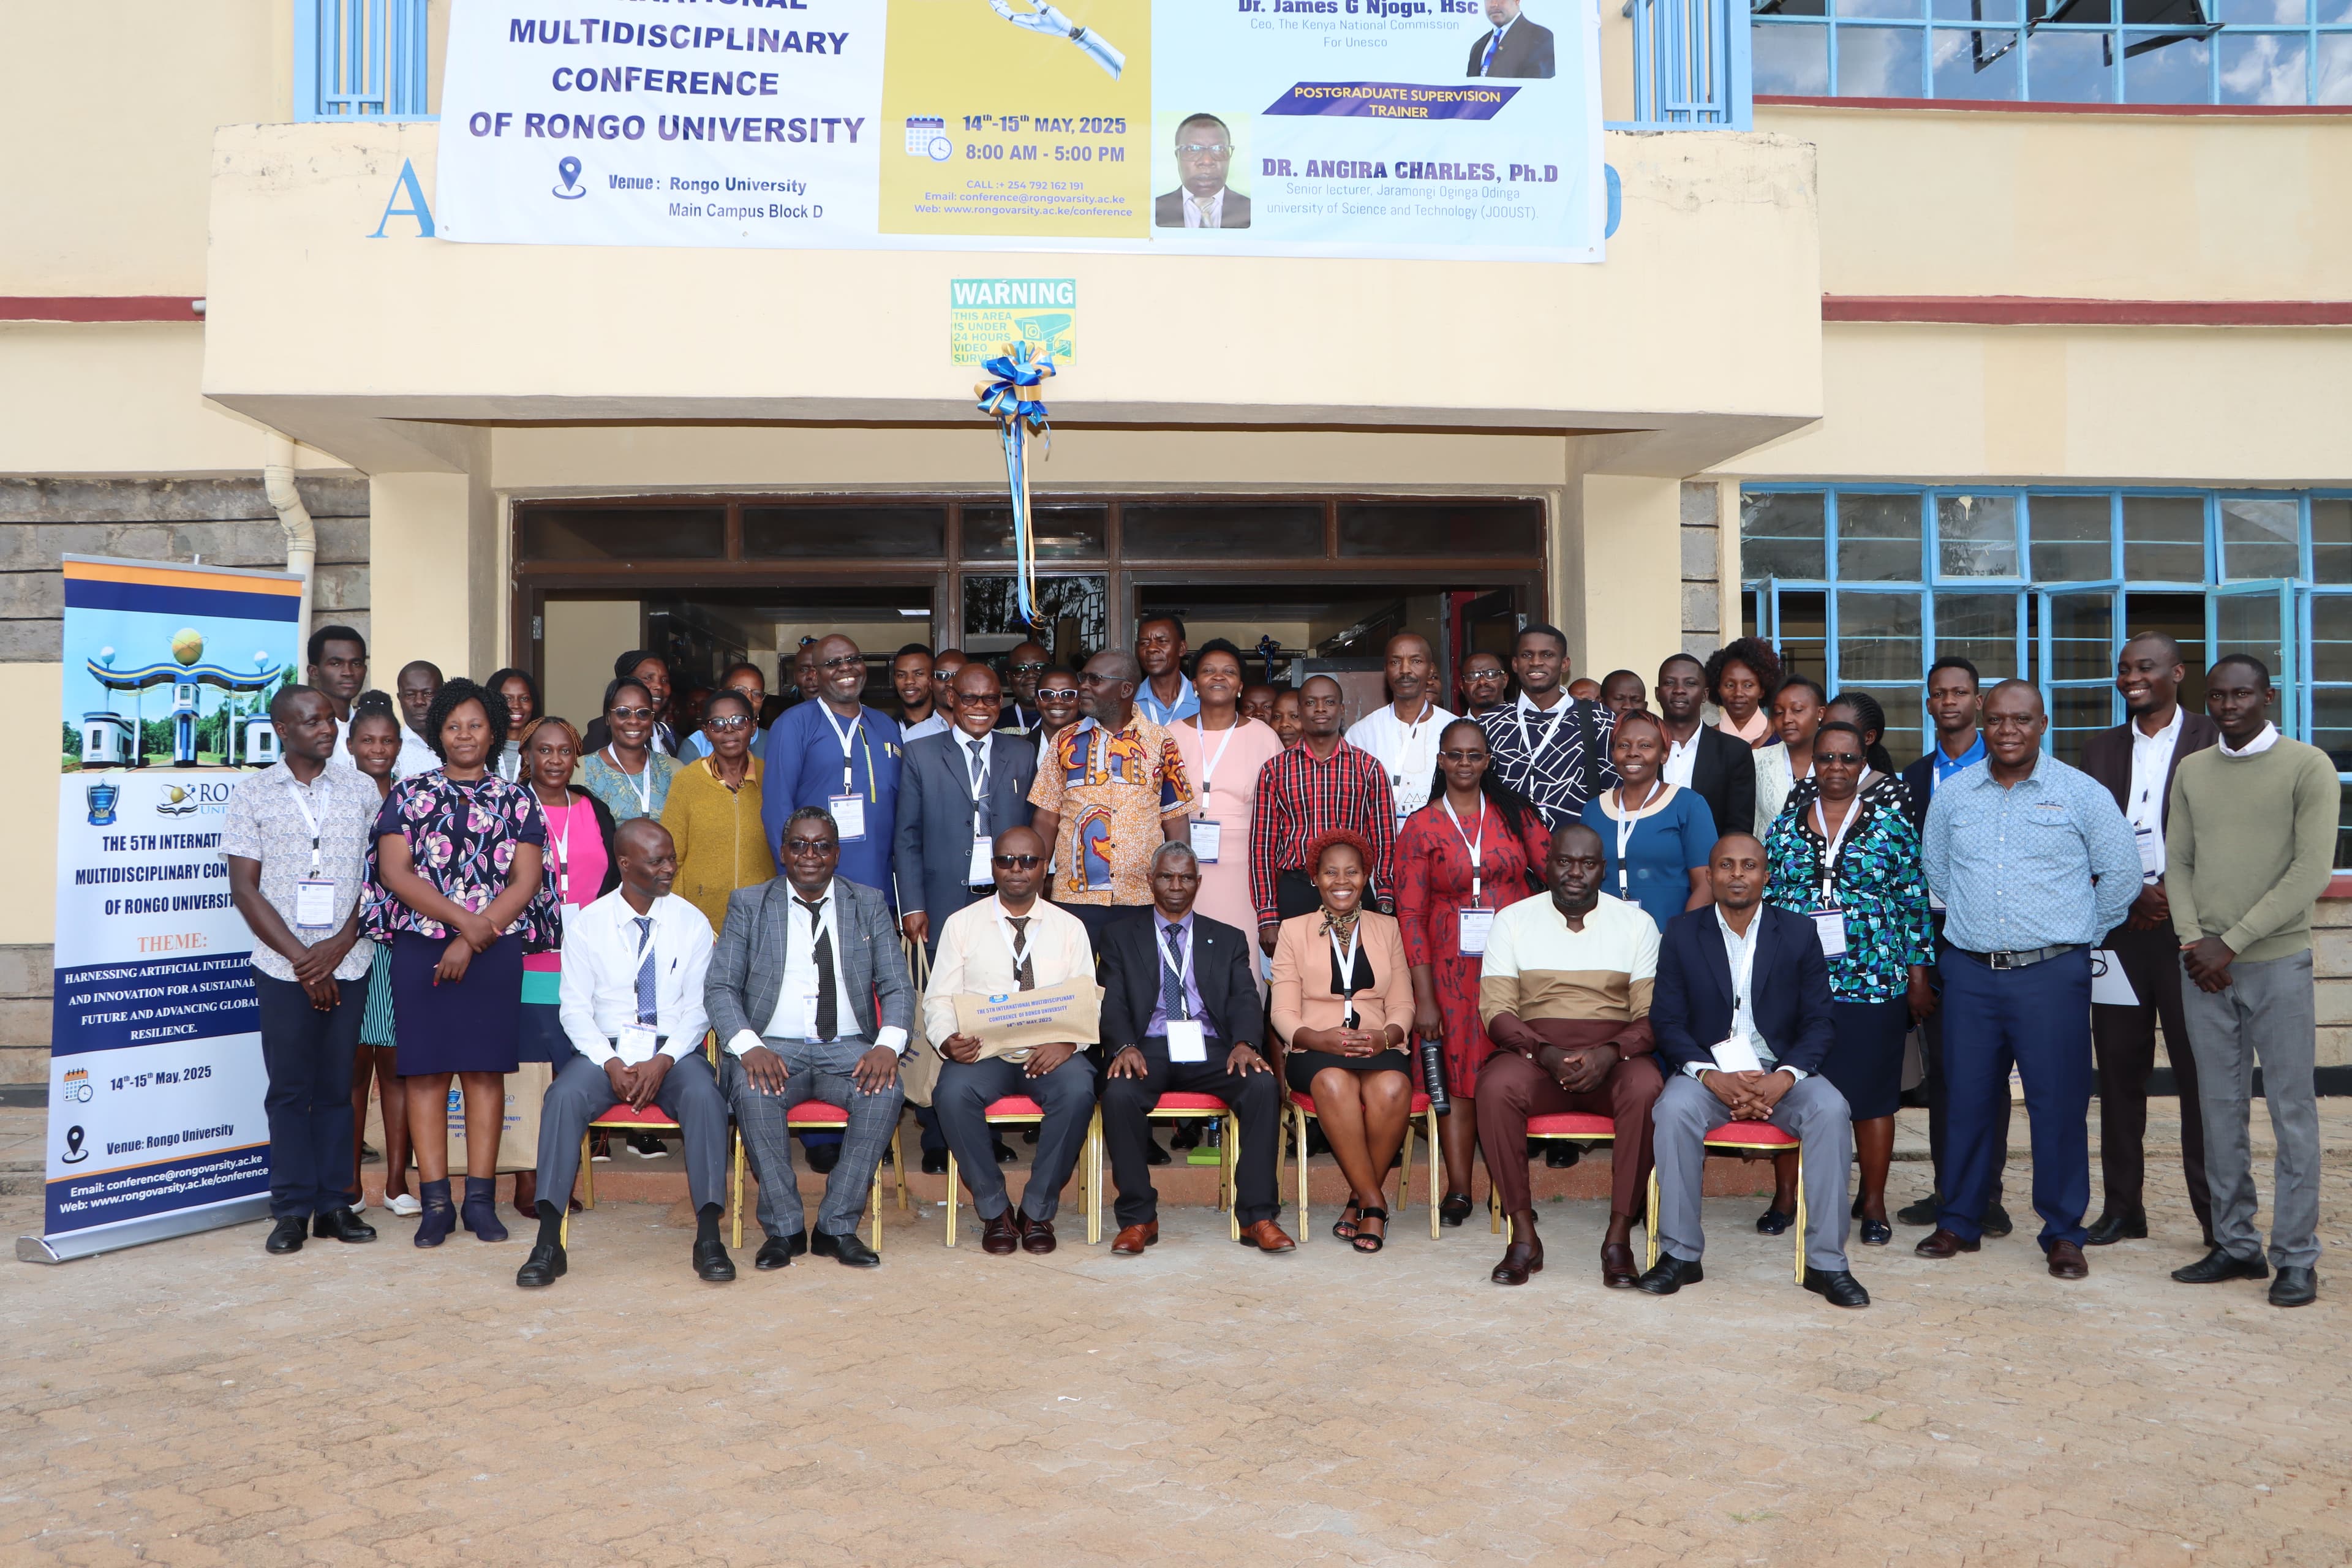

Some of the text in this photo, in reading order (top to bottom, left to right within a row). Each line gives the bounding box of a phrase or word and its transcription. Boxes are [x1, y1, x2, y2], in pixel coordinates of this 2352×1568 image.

[1251, 18, 1459, 32] Ceo, The Kenya National Commission
[509, 18, 849, 56] MULTIDISCIPLINARY
[1324, 37, 1387, 47] For Unesco
[551, 67, 779, 97] CONFERENCE
[1295, 87, 1501, 104] POSTGRADUATE SUPERVISION
[1370, 105, 1428, 118] TRAINER
[469, 111, 865, 143] OF RONGO UNIVERSITY
[1035, 118, 1075, 135] MAY,
[1080, 117, 1126, 134] 2025
[966, 144, 1004, 160] 8:00
[1009, 145, 1037, 160] AM
[1055, 146, 1092, 162] 5:00
[1098, 147, 1125, 162] PM
[1262, 158, 1558, 183] DR. ANGIRA CHARLES, Ph.D
[669, 176, 720, 196] Rongo
[725, 176, 807, 197] University
[967, 180, 993, 189] CALL
[1008, 181, 1026, 189] 254
[1029, 181, 1047, 190] 792
[1069, 182, 1084, 190] 191
[1286, 183, 1520, 201] Senior lecturer, Jaramongi Oginga Odinga
[925, 192, 1125, 205] Email: conference@rongovarsity.ac.ke
[669, 202, 823, 222] Main Campus Block D
[914, 205, 1133, 217] Web: www.rongovarsity.ac.ke/conference
[1267, 203, 1323, 216] university
[1327, 202, 1338, 214] of
[1342, 203, 1386, 215] Science
[1390, 204, 1410, 215] and
[1415, 205, 1477, 219] Technology
[954, 282, 1073, 304] WARNING
[954, 312, 1012, 320] THIS AREA
[103, 833, 221, 851] THE 5TH INTERNATI
[75, 863, 230, 885] MULTIDISCIPLINARY CON
[105, 893, 233, 915] OF RONGO UNIVERSIT
[138, 933, 207, 952] THEME:
[65, 957, 251, 984] HARNESSING ARTIFICIAL INTELLIG
[69, 978, 255, 1006] AND INNOVATION FOR A SUSTAINAB
[81, 997, 260, 1026] FUTURE AND ADVANCING GLOBAL
[130, 1023, 197, 1040] RESILIENCE.
[156, 1069, 181, 1084] May,
[184, 1065, 211, 1081] 2025
[107, 1124, 234, 1155] Venue: Rongo University
[70, 1155, 262, 1197] Email: conference@rongovarsity.ac.ke
[60, 1166, 268, 1213] Web: www.rongovarsity.ac.ke/conference
